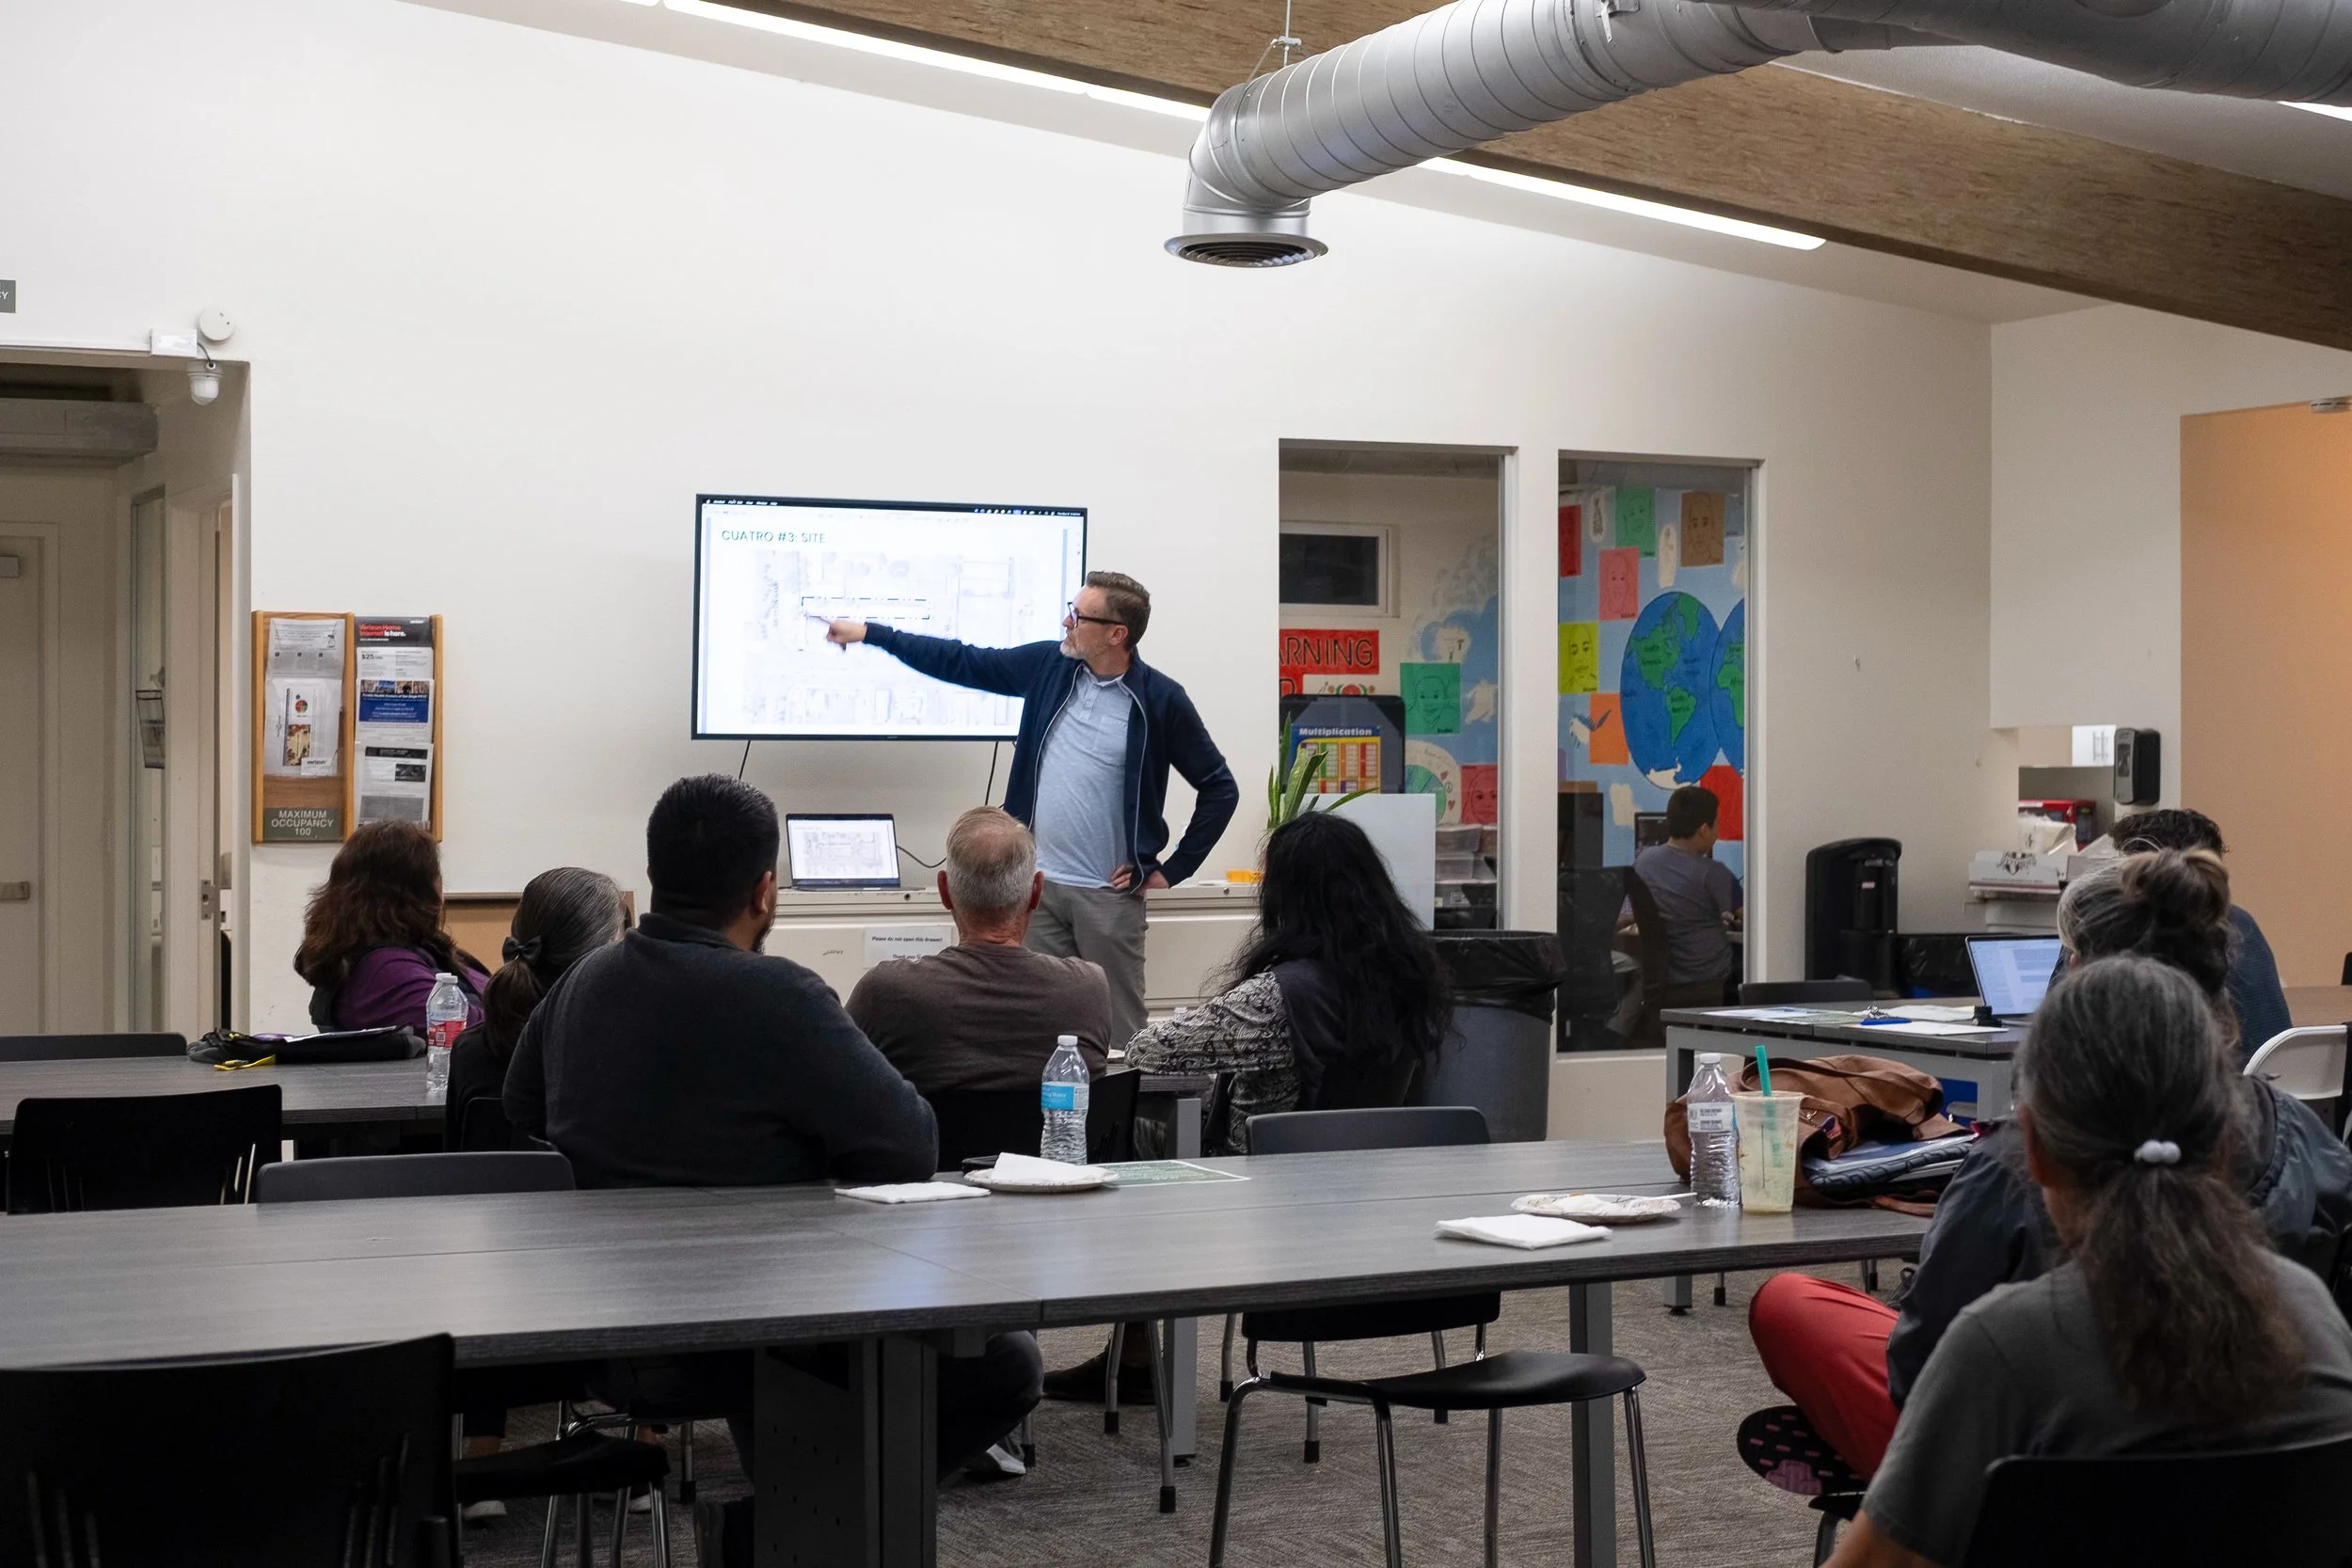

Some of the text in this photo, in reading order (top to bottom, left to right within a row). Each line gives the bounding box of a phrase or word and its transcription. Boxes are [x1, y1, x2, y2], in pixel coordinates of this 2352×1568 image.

[722, 530, 826, 543] CUATRO #3: SITE
[1279, 637, 1374, 666] RNING
[1299, 728, 1372, 736] Multiplication
[278, 810, 326, 818] MAXIMUM
[271, 818, 333, 828] OCCUPANCY
[294, 827, 311, 835] 100
